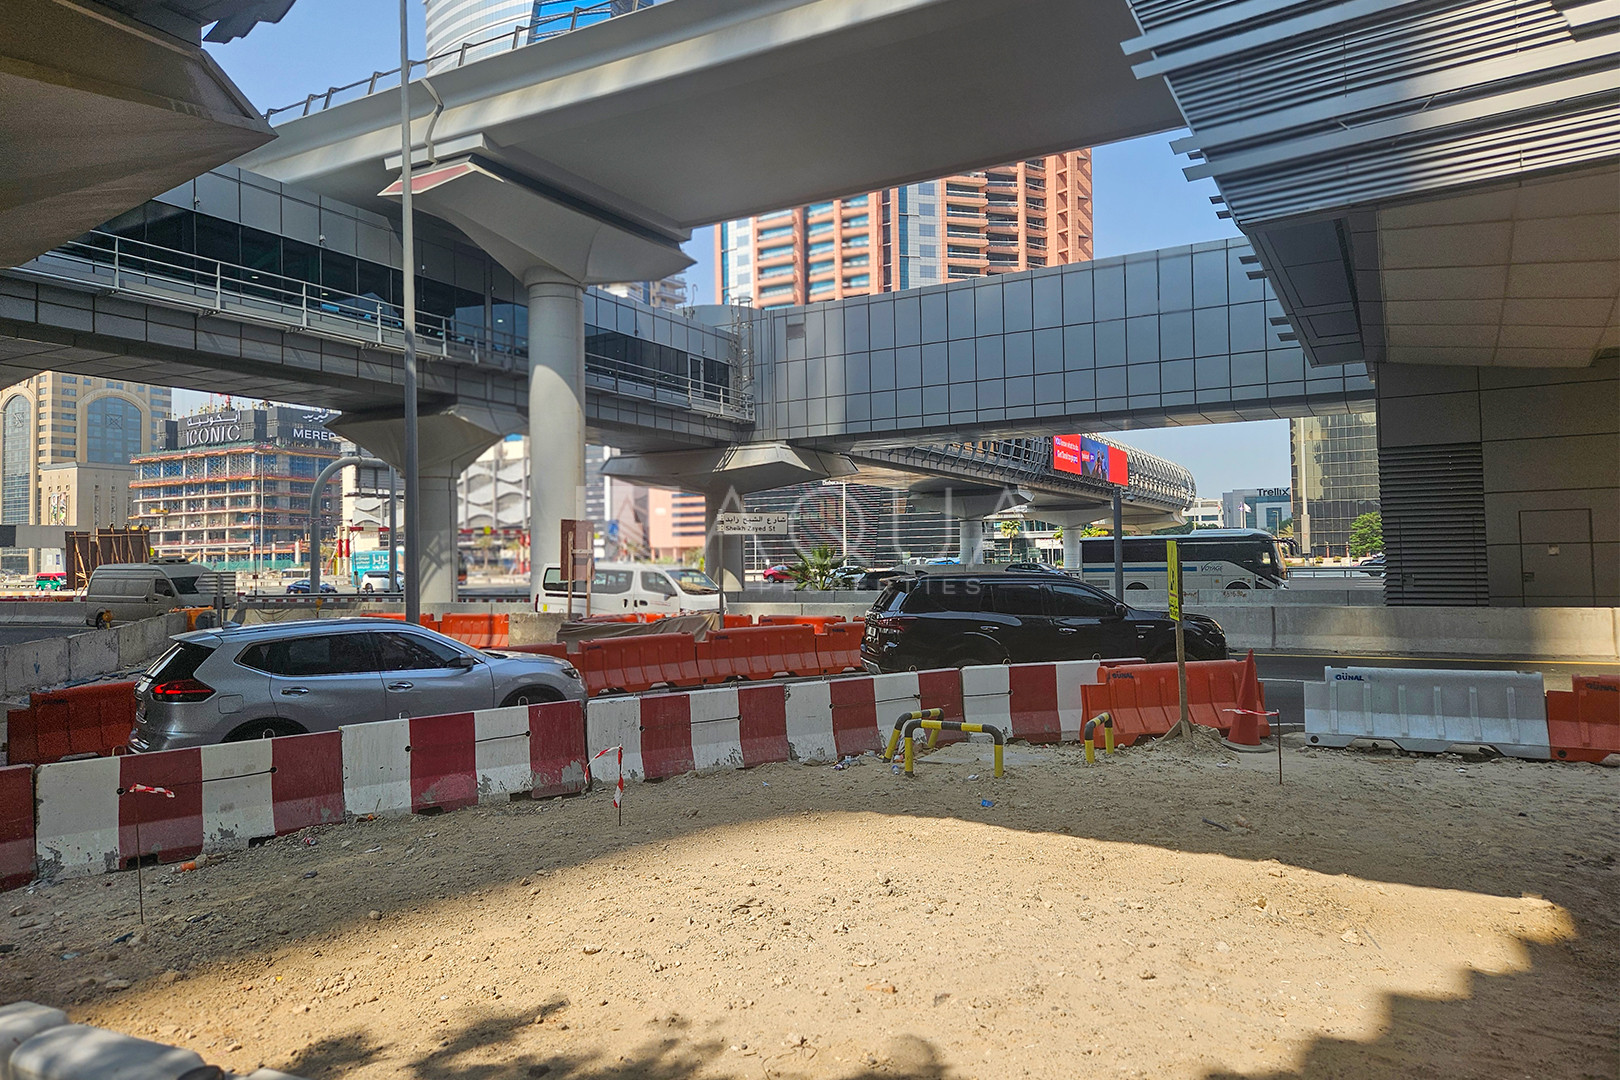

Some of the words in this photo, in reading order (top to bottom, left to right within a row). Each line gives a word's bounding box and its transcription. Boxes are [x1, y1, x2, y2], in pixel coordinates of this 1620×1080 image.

[186, 425, 240, 446] ICONIC
[293, 429, 337, 441] MERED
[725, 515, 740, 524] زايد
[742, 515, 763, 525] الشيخ
[766, 516, 786, 525] شارع
[1335, 673, 1365, 681] GÜNAL
